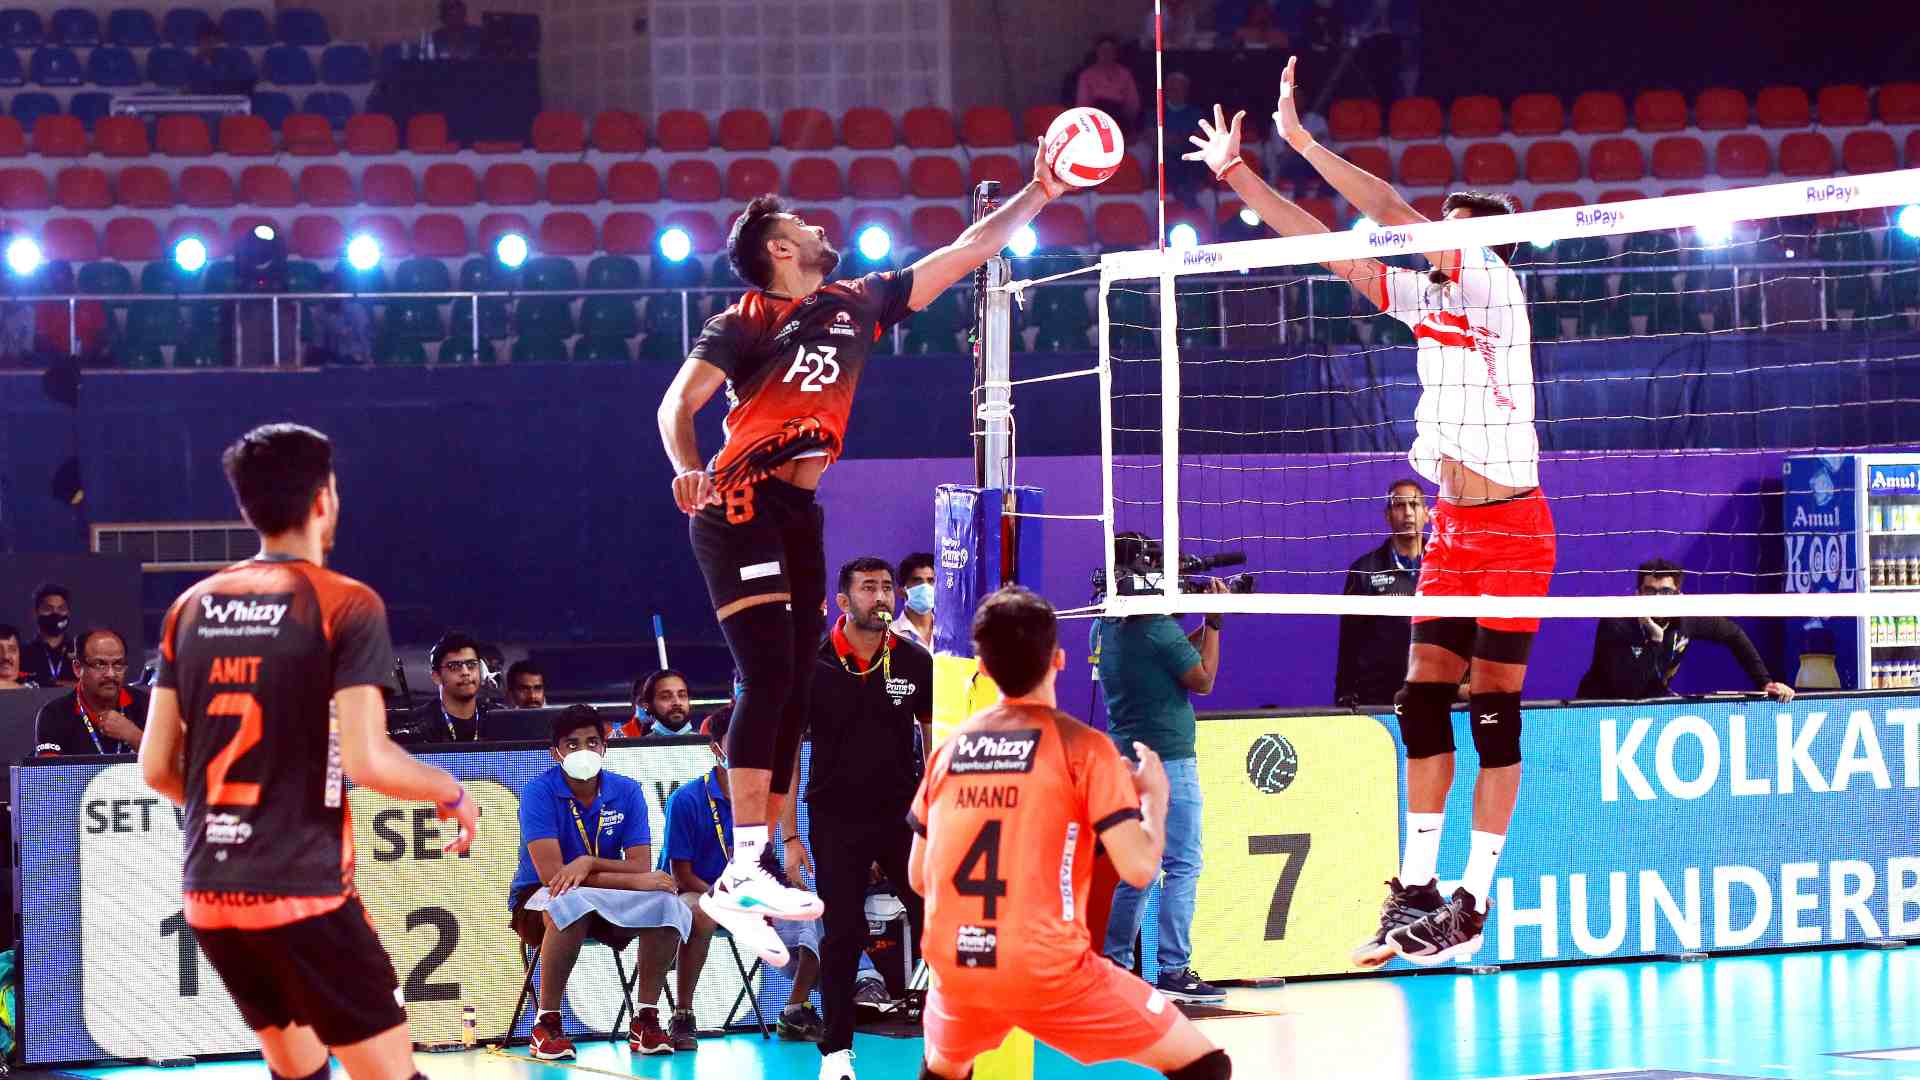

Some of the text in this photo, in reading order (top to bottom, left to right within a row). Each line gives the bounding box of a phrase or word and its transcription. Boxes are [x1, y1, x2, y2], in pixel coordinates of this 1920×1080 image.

[1807, 184, 1852, 203] RuPay
[1576, 209, 1617, 227] RuPay
[1369, 231, 1406, 248] RuPay
[1184, 250, 1217, 266] RuPay
[782, 345, 840, 391] A23
[1872, 470, 1915, 489] Amul
[1793, 505, 1839, 527] Amul
[1784, 533, 1855, 592] KOOL
[201, 595, 287, 625] Whizzy
[208, 656, 263, 684] AMIT
[206, 692, 263, 806] 2
[958, 734, 1035, 760] Whizzy
[955, 785, 1019, 809] ANAND
[86, 798, 158, 834] SET
[952, 820, 1006, 920] 4
[1248, 833, 1310, 941] 7
[160, 905, 199, 996] 1
[402, 906, 461, 1002] 2
